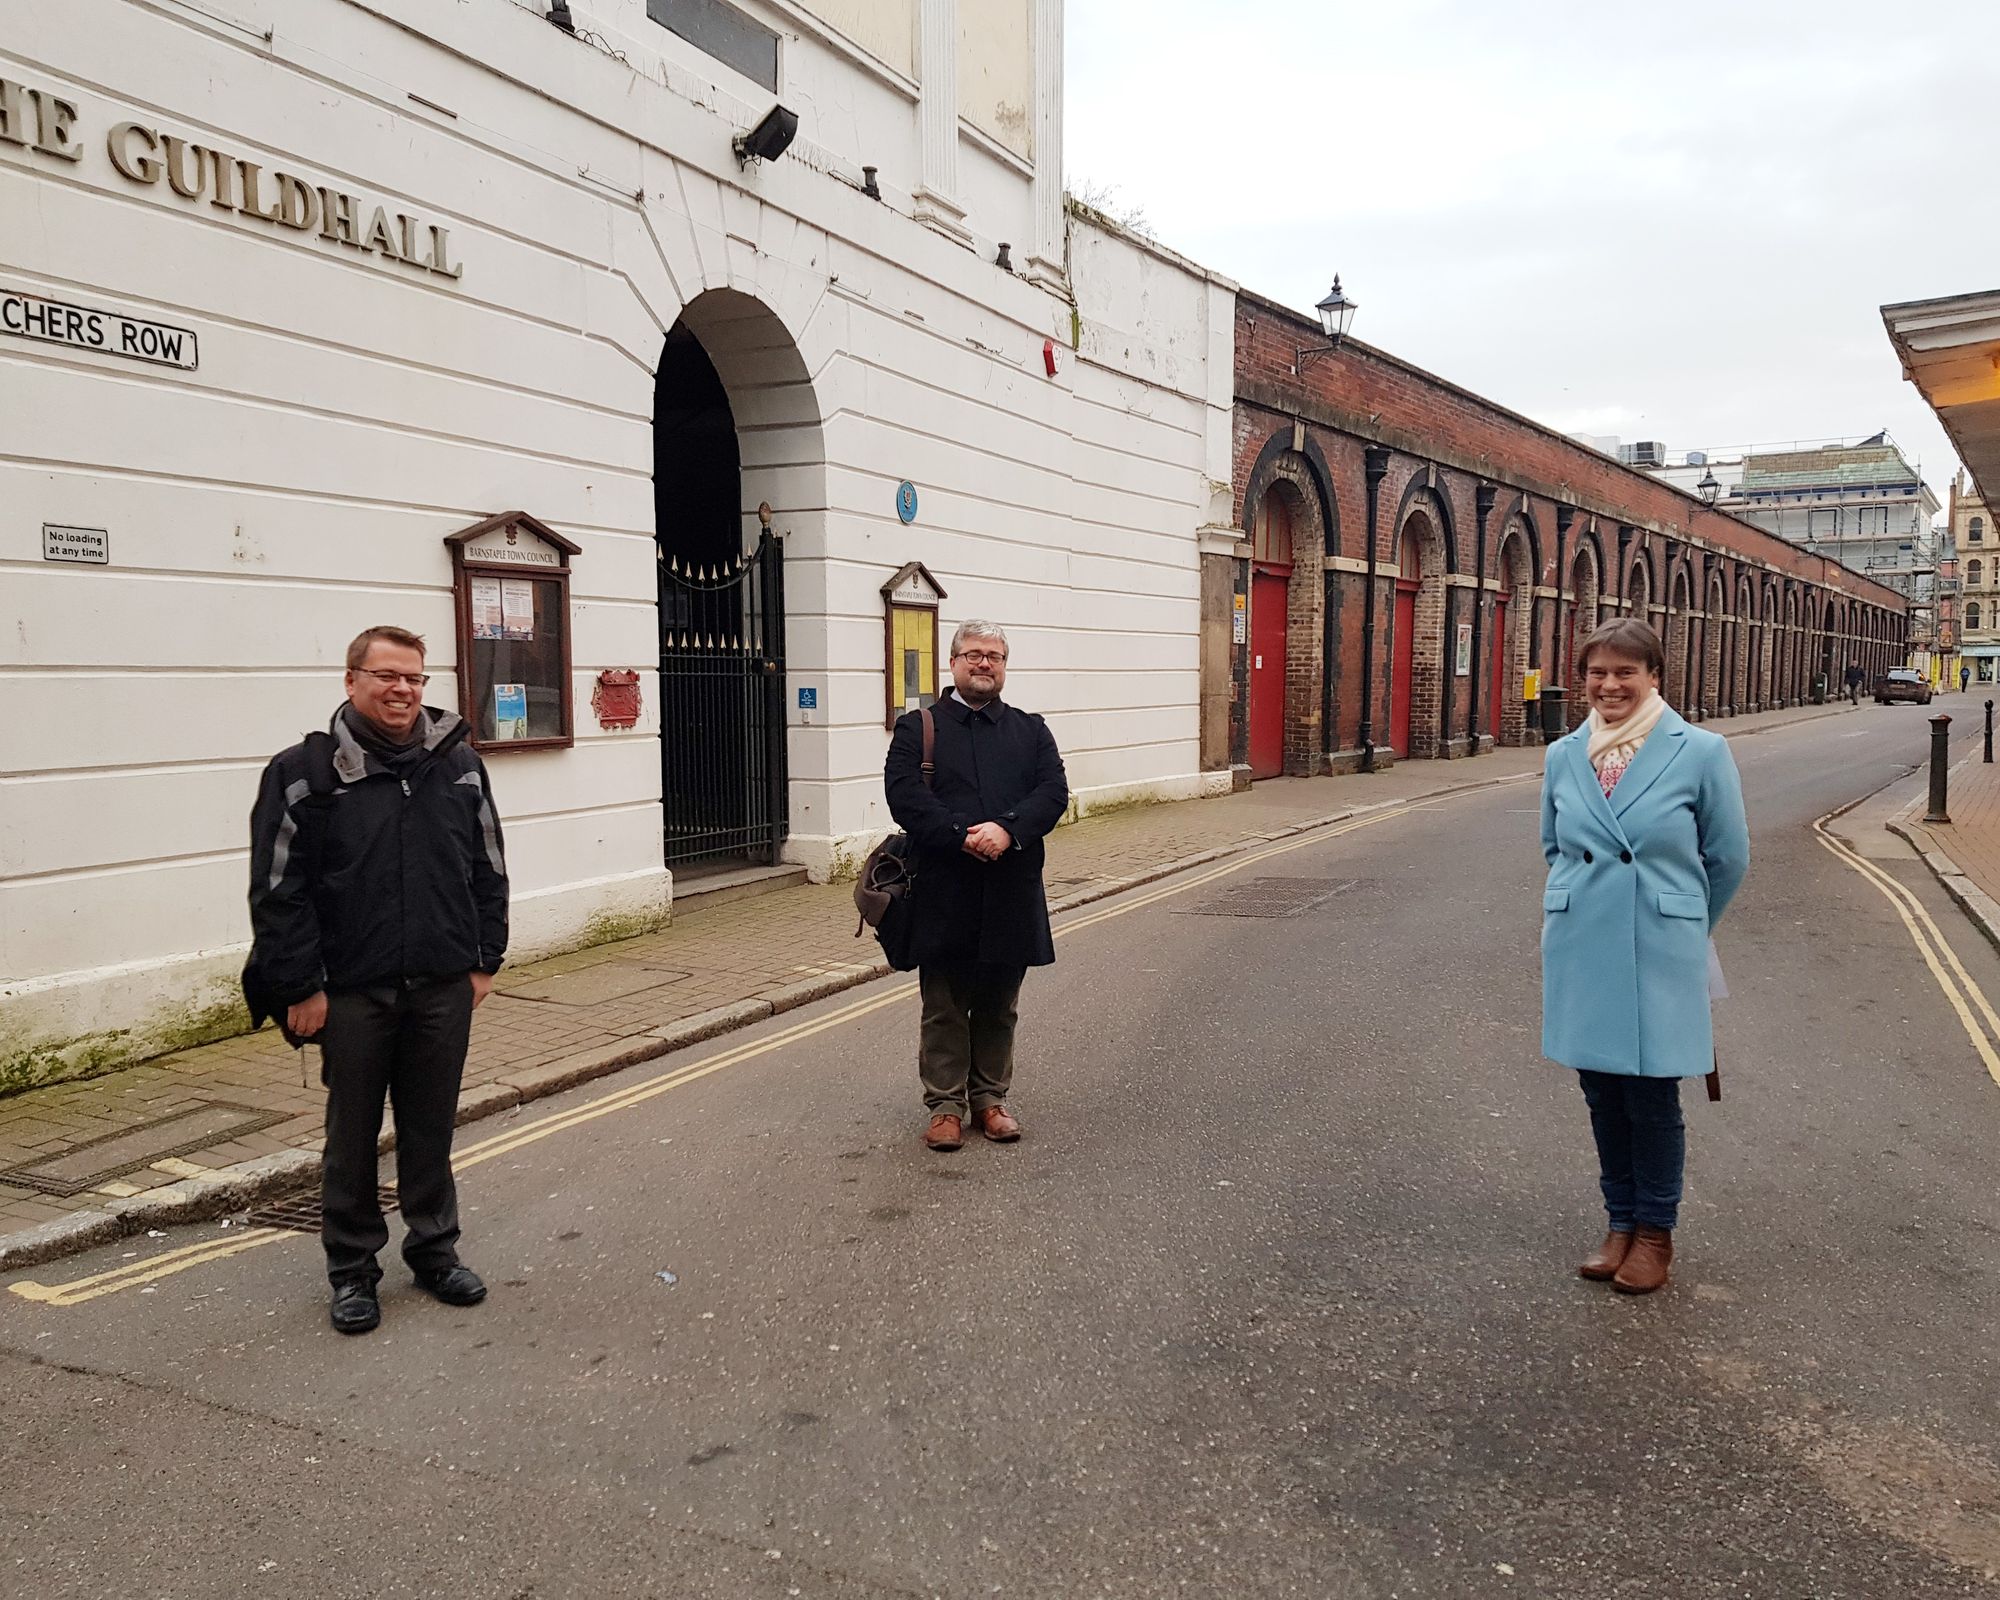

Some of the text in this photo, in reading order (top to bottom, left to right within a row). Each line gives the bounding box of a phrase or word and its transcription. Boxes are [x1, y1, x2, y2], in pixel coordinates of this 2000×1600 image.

[107, 121, 463, 279] GUILDHALL
[2, 298, 182, 361] CHERS ROW
[50, 531, 102, 545] No loading
[49, 546, 103, 557] at any time
[470, 547, 554, 563] BARNSTAPLE TOWN COUNCIL
